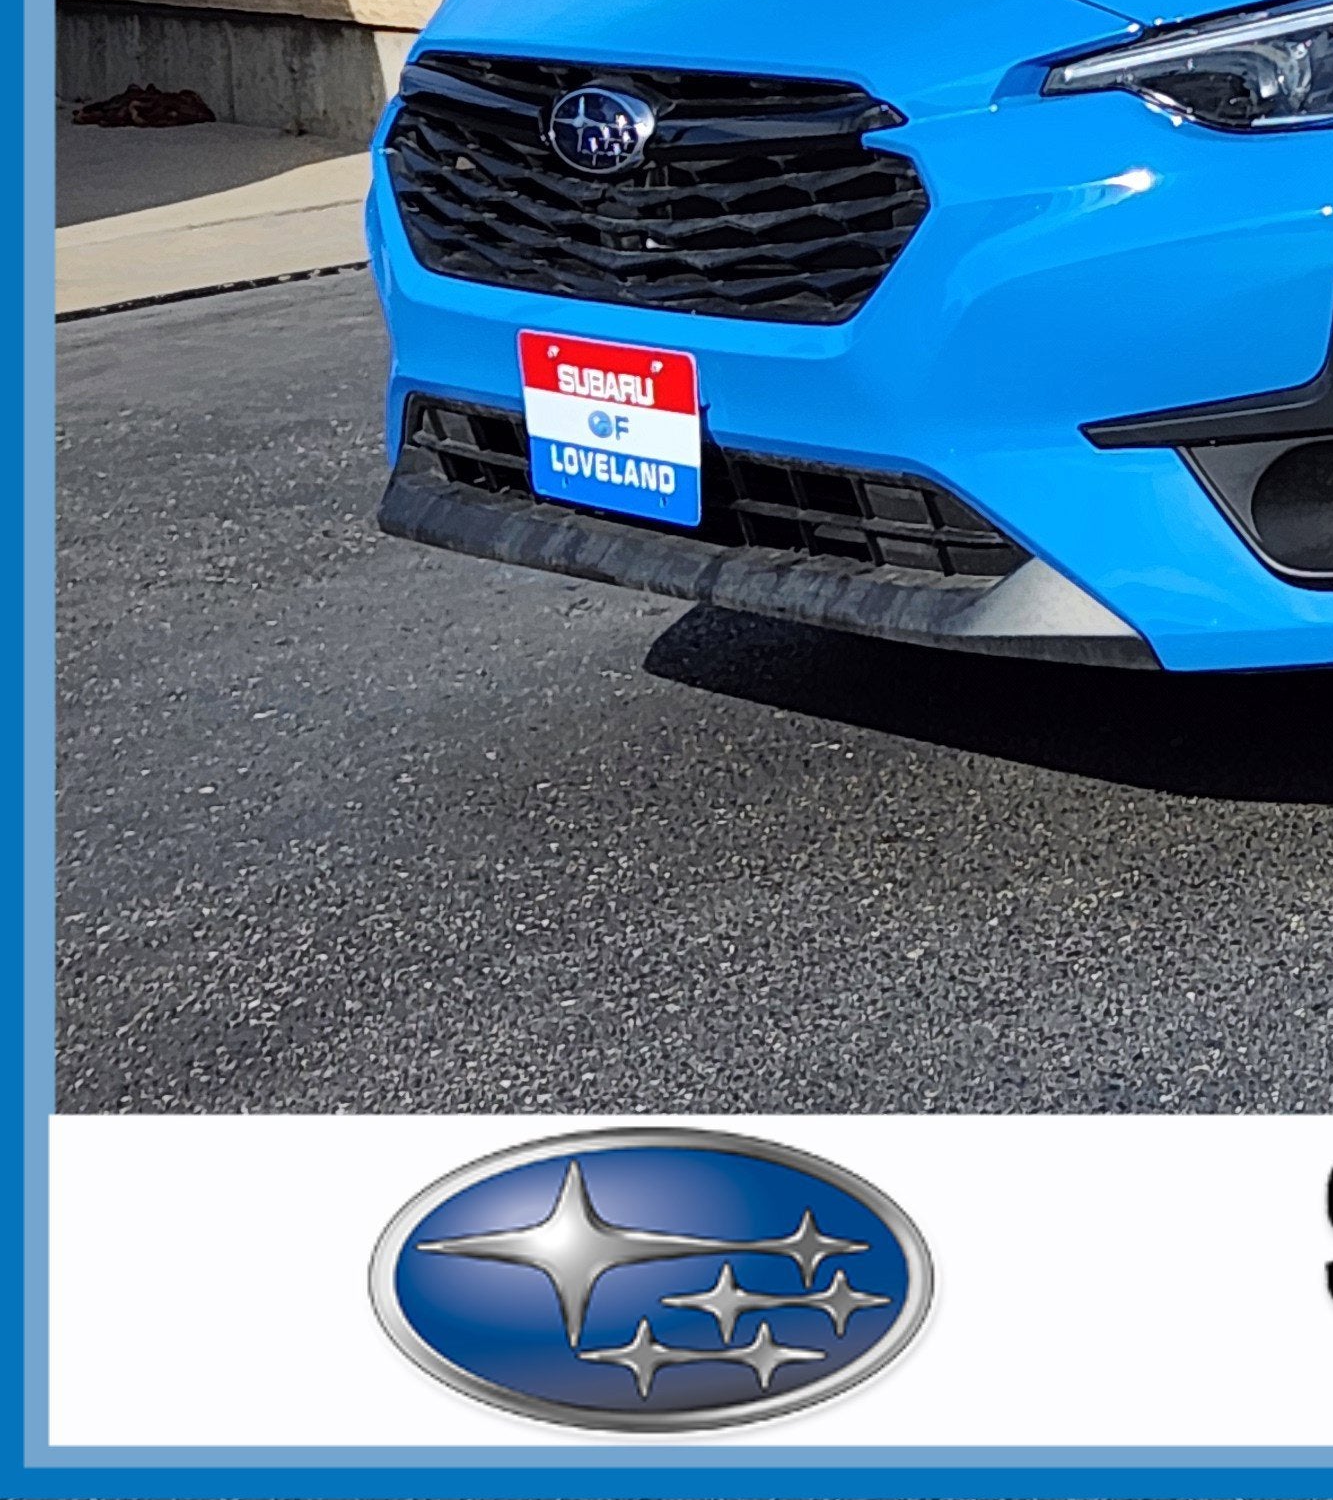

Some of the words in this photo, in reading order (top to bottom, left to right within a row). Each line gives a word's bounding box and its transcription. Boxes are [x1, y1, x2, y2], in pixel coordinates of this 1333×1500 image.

[556, 362, 655, 406] SUBARU
[588, 410, 630, 440] OF
[551, 443, 676, 495] LOVELAND
